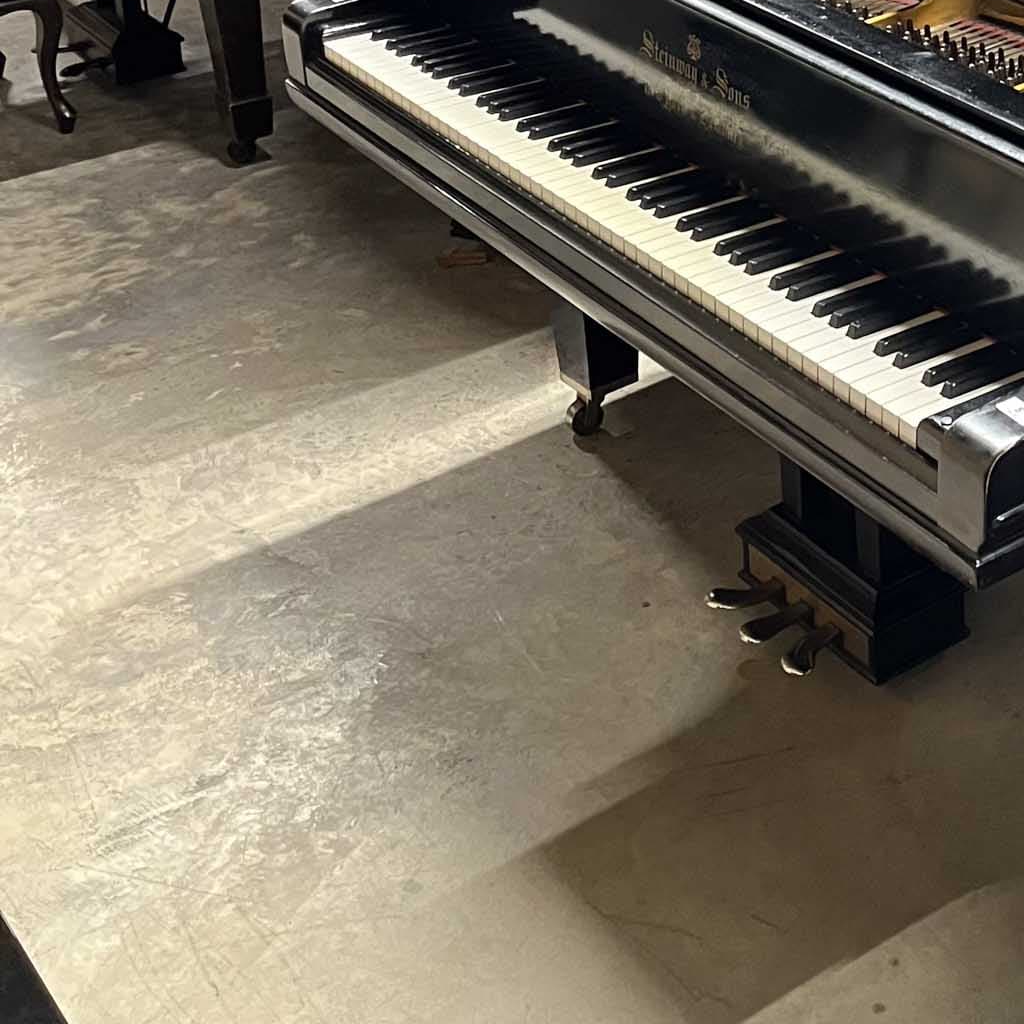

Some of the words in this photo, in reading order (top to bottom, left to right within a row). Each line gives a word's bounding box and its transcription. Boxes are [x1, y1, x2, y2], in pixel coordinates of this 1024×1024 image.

[640, 30, 698, 85] Steinway
[701, 71, 711, 89] &
[712, 67, 751, 109] Sons
